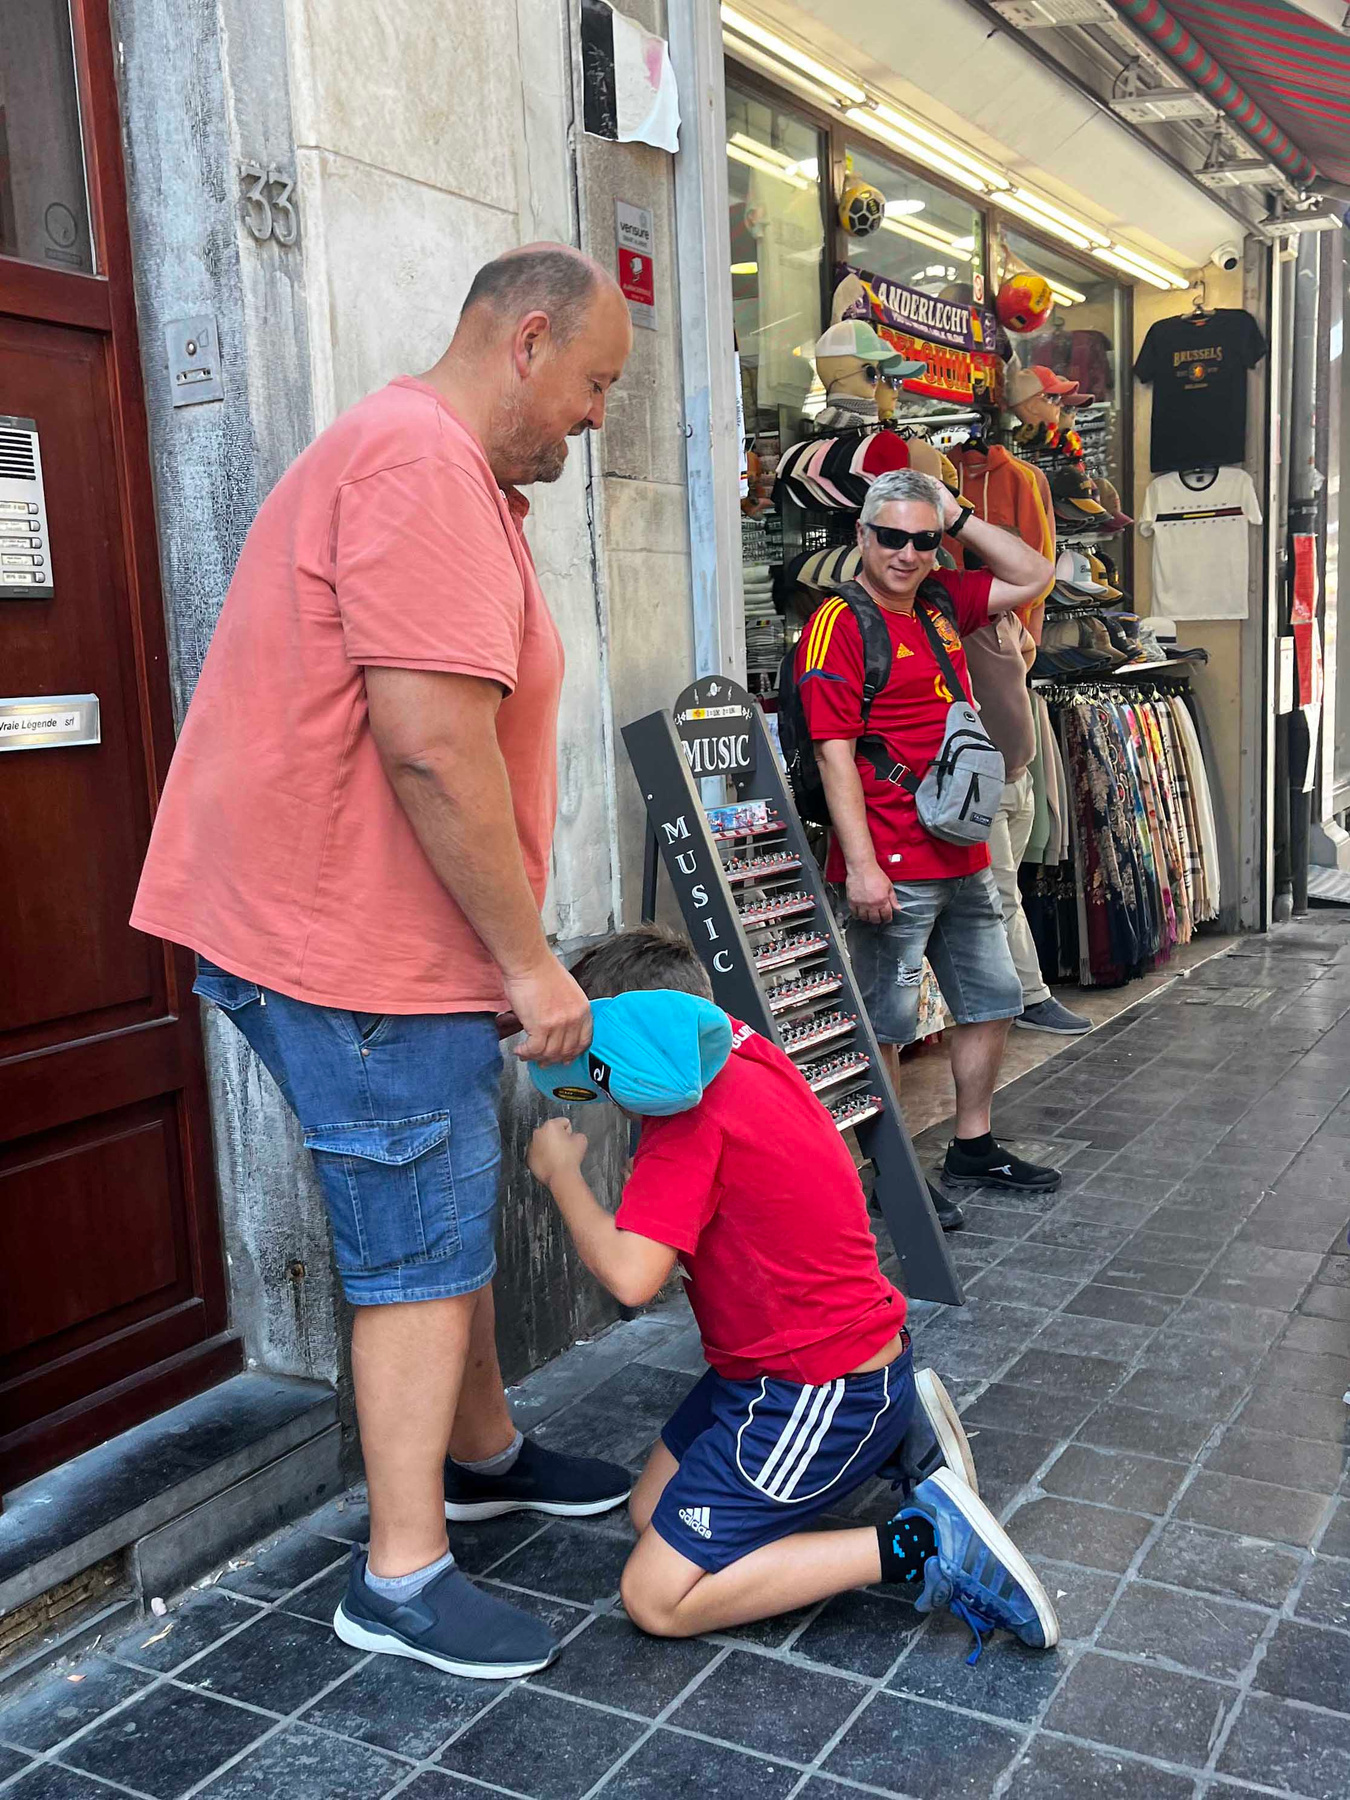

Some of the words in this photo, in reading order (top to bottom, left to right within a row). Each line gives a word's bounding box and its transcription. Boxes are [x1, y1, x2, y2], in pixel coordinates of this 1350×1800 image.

[240, 163, 297, 246] 33
[878, 282, 969, 334] ANDERLECHT
[681, 735, 750, 772] MUSIC
[661, 815, 734, 973] MUSIC
[678, 1508, 712, 1540] adidas
